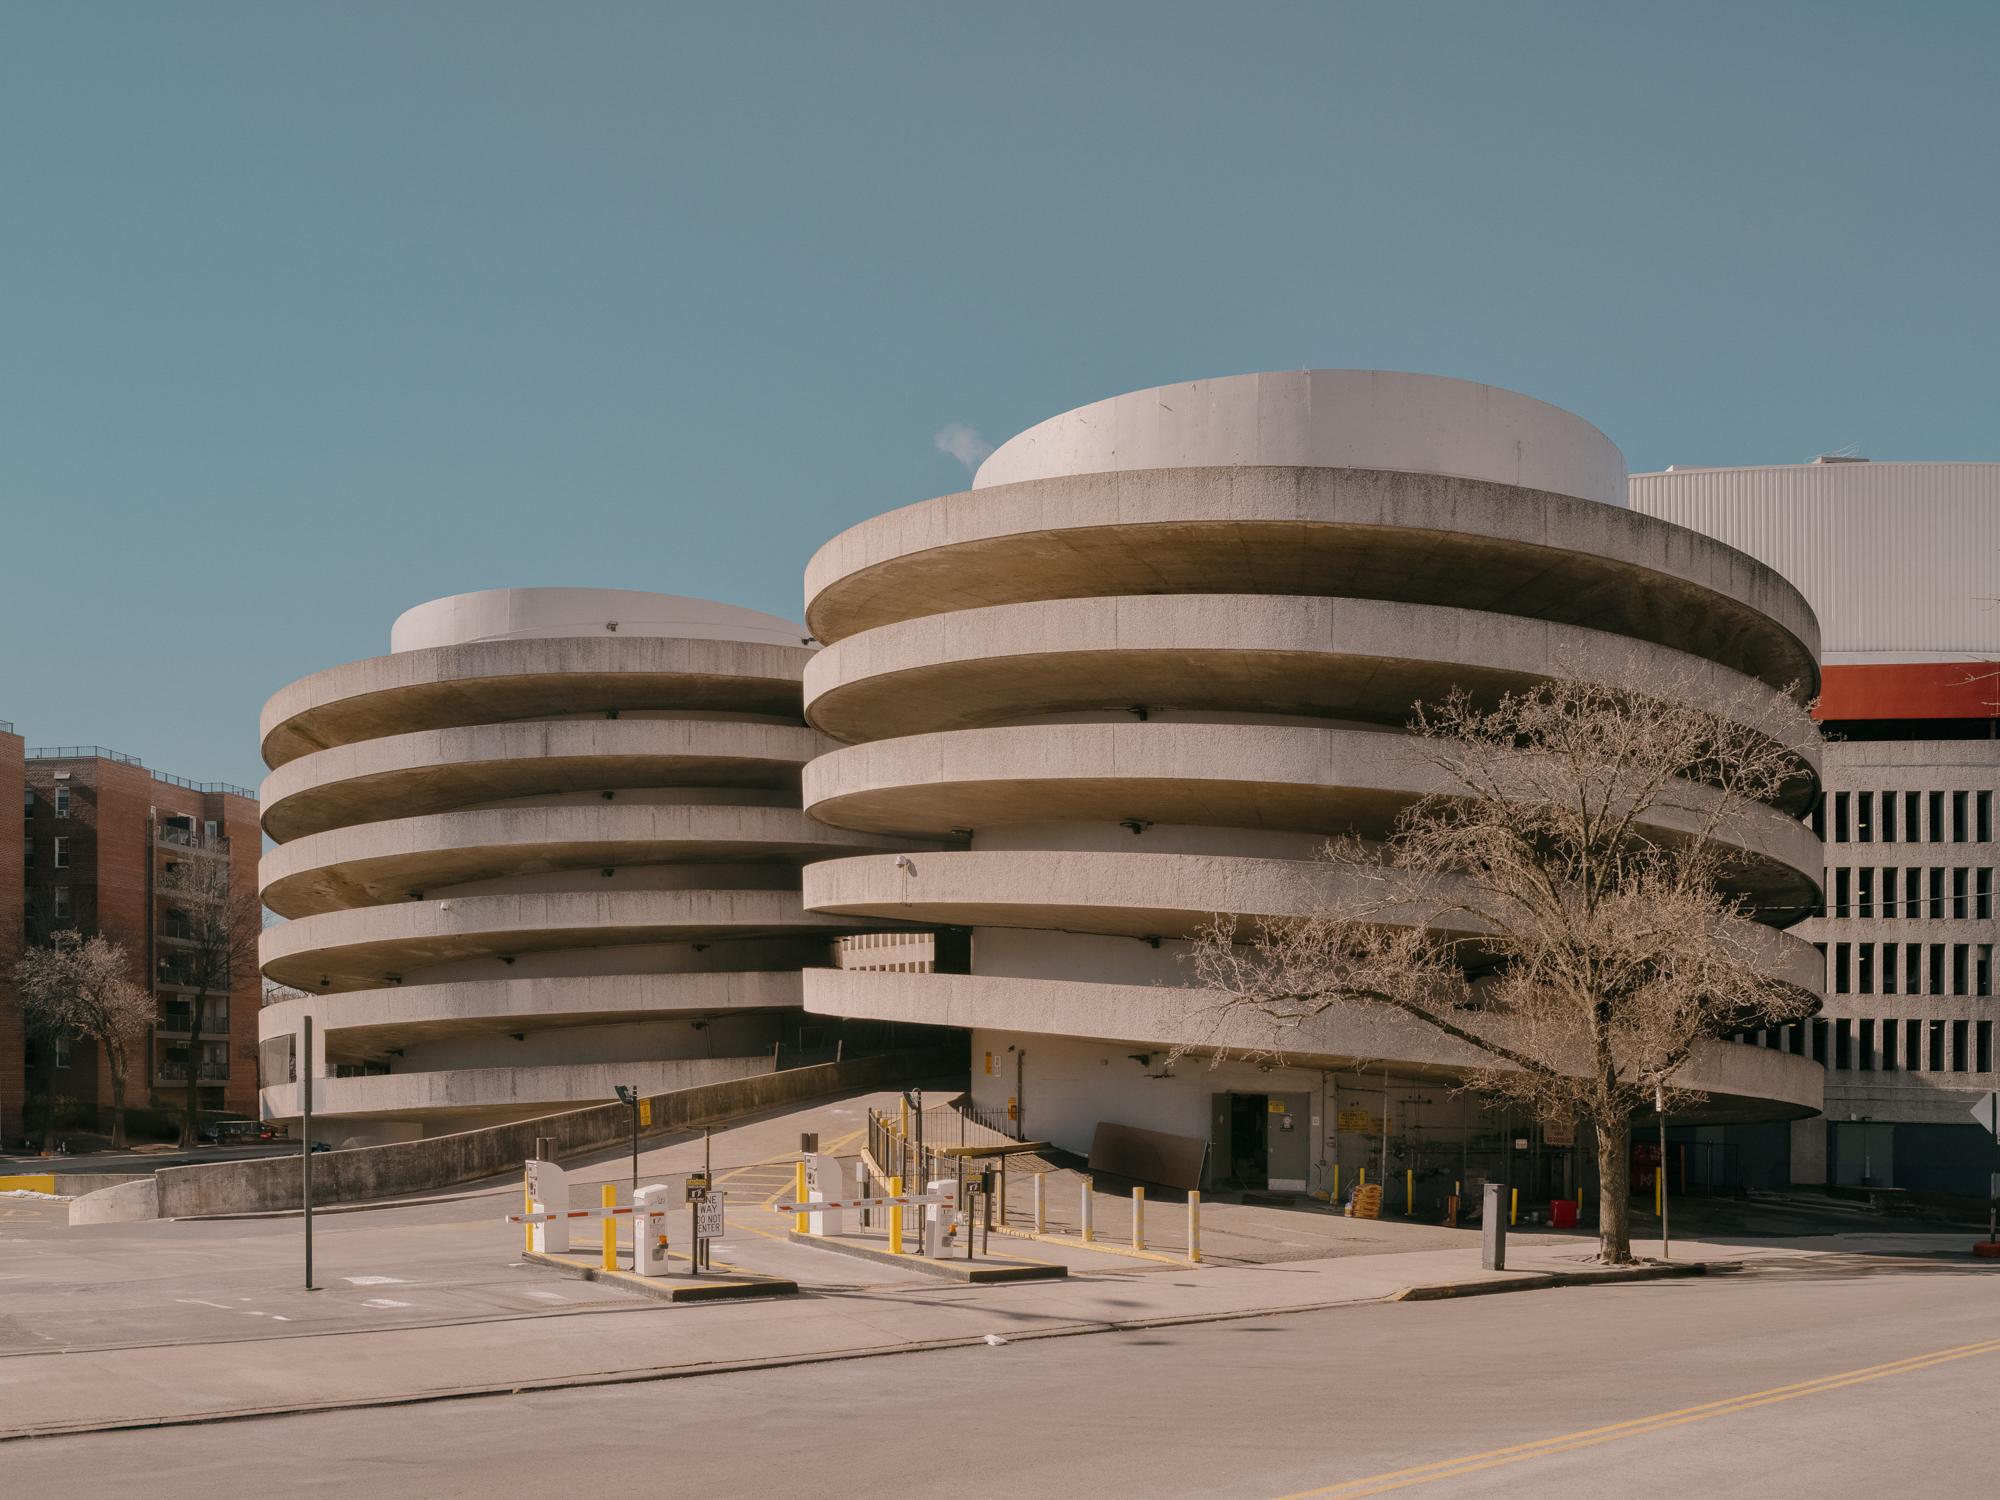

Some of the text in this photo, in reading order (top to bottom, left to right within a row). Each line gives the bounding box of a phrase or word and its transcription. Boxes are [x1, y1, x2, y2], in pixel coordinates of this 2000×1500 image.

[700, 1204, 717, 1213] WAY
[708, 1214, 721, 1223] NOT
[698, 1223, 721, 1233] ENTER
